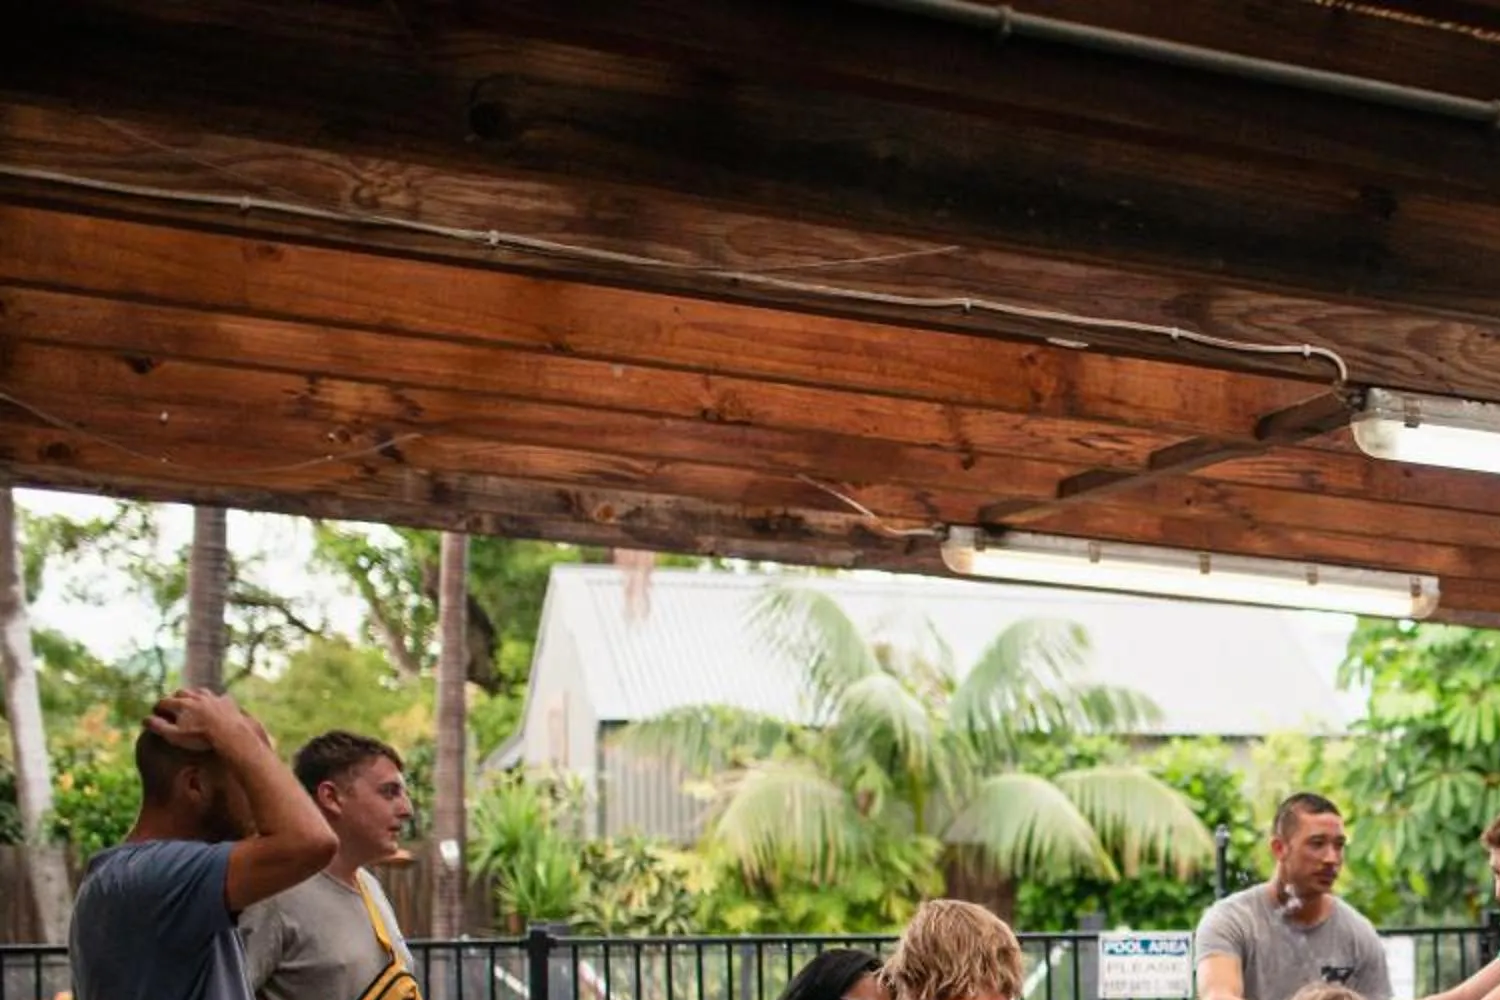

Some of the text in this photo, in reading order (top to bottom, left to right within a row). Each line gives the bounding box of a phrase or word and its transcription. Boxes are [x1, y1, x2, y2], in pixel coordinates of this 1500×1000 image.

[1104, 939, 1189, 955] POOL AREA
[1106, 961, 1181, 975] PLEASE
